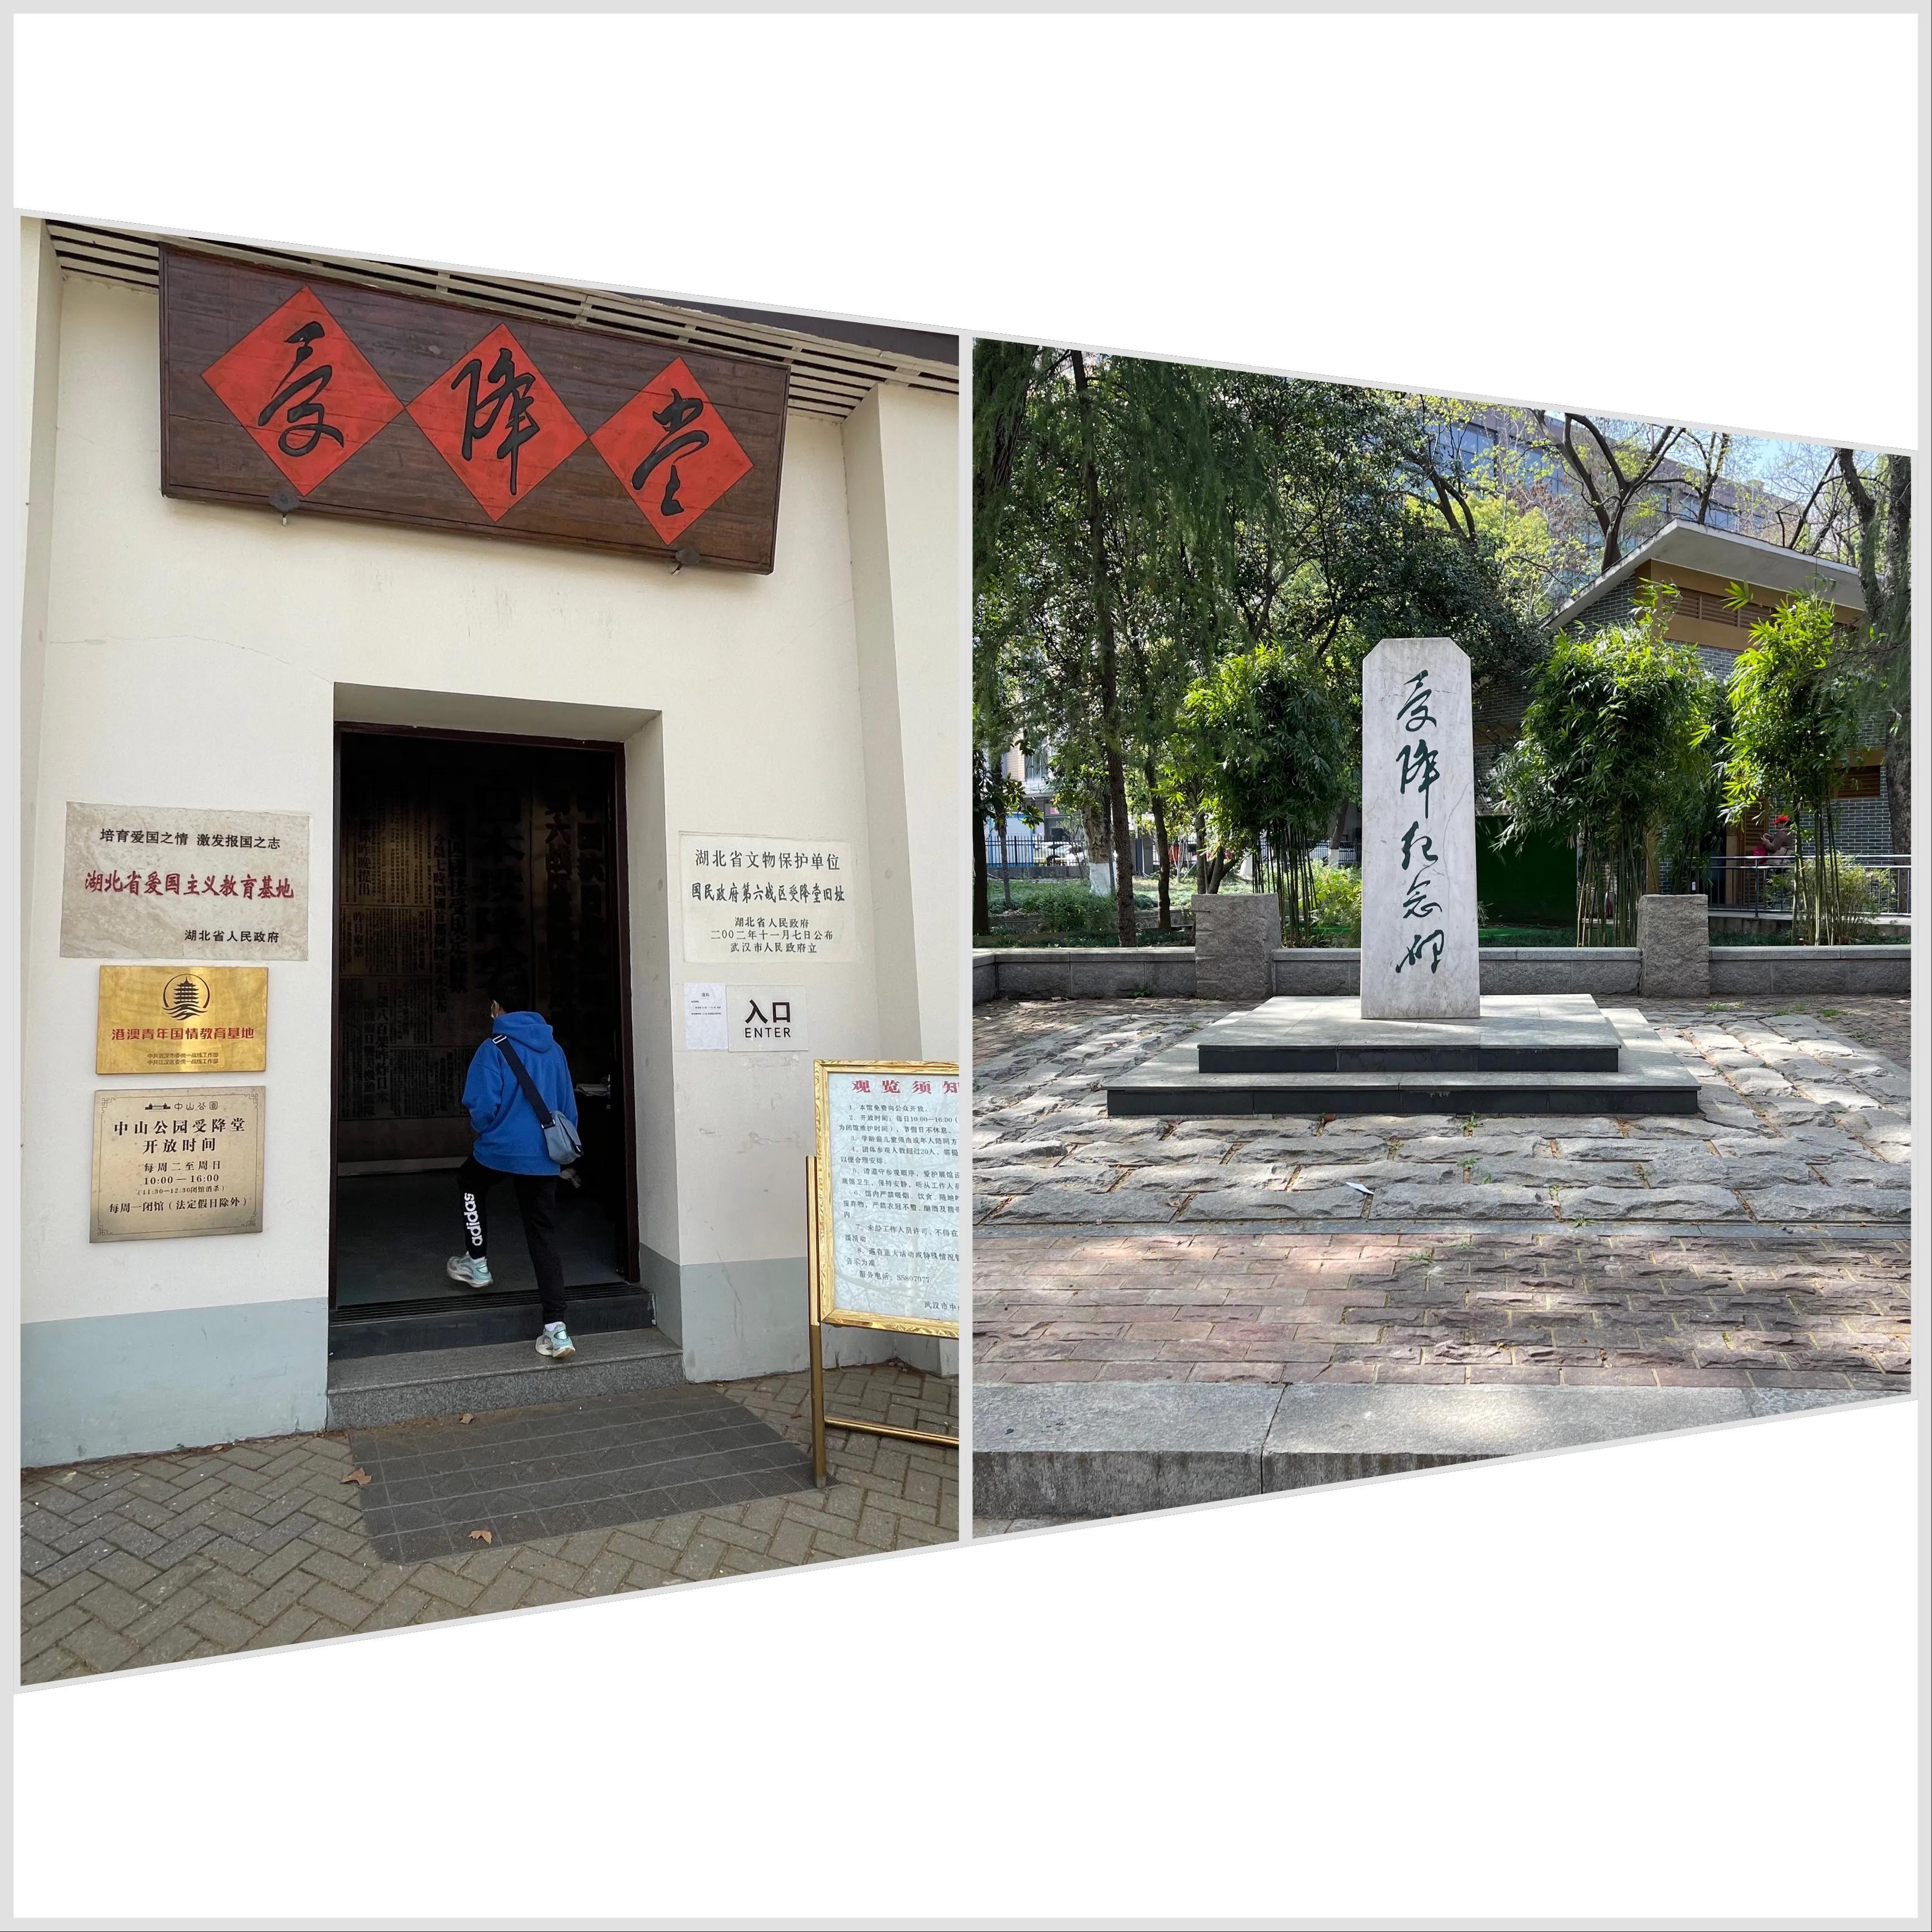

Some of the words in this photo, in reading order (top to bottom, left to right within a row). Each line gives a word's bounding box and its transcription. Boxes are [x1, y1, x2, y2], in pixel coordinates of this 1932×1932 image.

[258, 321, 710, 517] 受降堂
[1396, 669, 1445, 974] 受降纪念碑
[100, 829, 188, 845] 培育爱国之情
[196, 833, 281, 849] 激发报国之志
[695, 849, 840, 870] 湖北省文物保护单位
[85, 870, 294, 899] 湖北省爱国主义教育基地
[692, 882, 845, 903] 国民政府第六战区受降堂旧址
[734, 917, 810, 929] 湖北省人民政府
[184, 929, 280, 943] 湖北省人民政府
[730, 942, 817, 953] 武汉市人民政府立
[744, 999, 791, 1024] 入口
[112, 1027, 254, 1040] 港澳青年国情教育基地
[744, 1027, 792, 1038] ENTER
[114, 1117, 245, 1136] 中山公园受降堂
[143, 1137, 216, 1154] 开放时间
[144, 1160, 221, 1173] 每周二至周日
[464, 1192, 483, 1247] adidas
